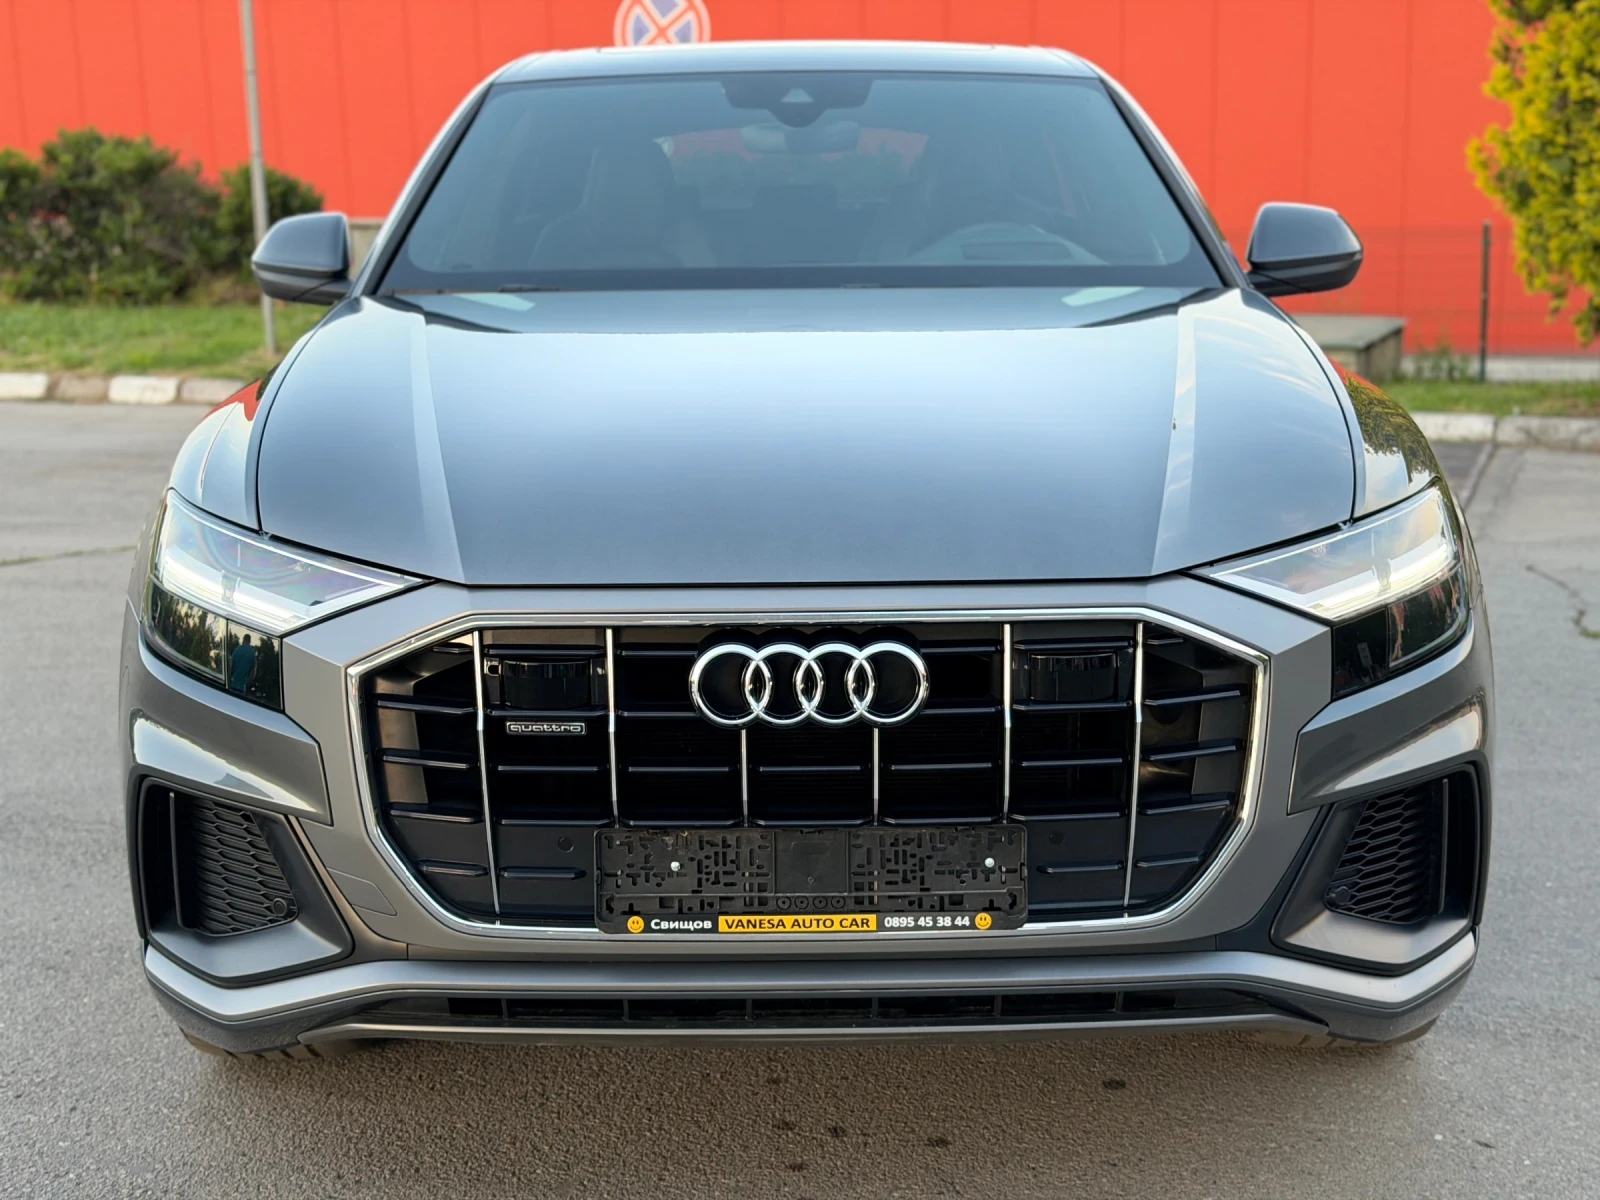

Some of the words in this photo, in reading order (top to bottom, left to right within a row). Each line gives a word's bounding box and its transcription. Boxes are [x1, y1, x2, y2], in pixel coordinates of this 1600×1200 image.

[510, 724, 581, 732] quattro
[650, 917, 712, 931] Свищов
[725, 918, 787, 930] VANESA
[791, 917, 834, 929] AUTO
[839, 917, 871, 929] CAR
[884, 916, 915, 928] 0895
[917, 916, 934, 928] 45
[936, 916, 952, 928] 38
[954, 915, 970, 927] 44
